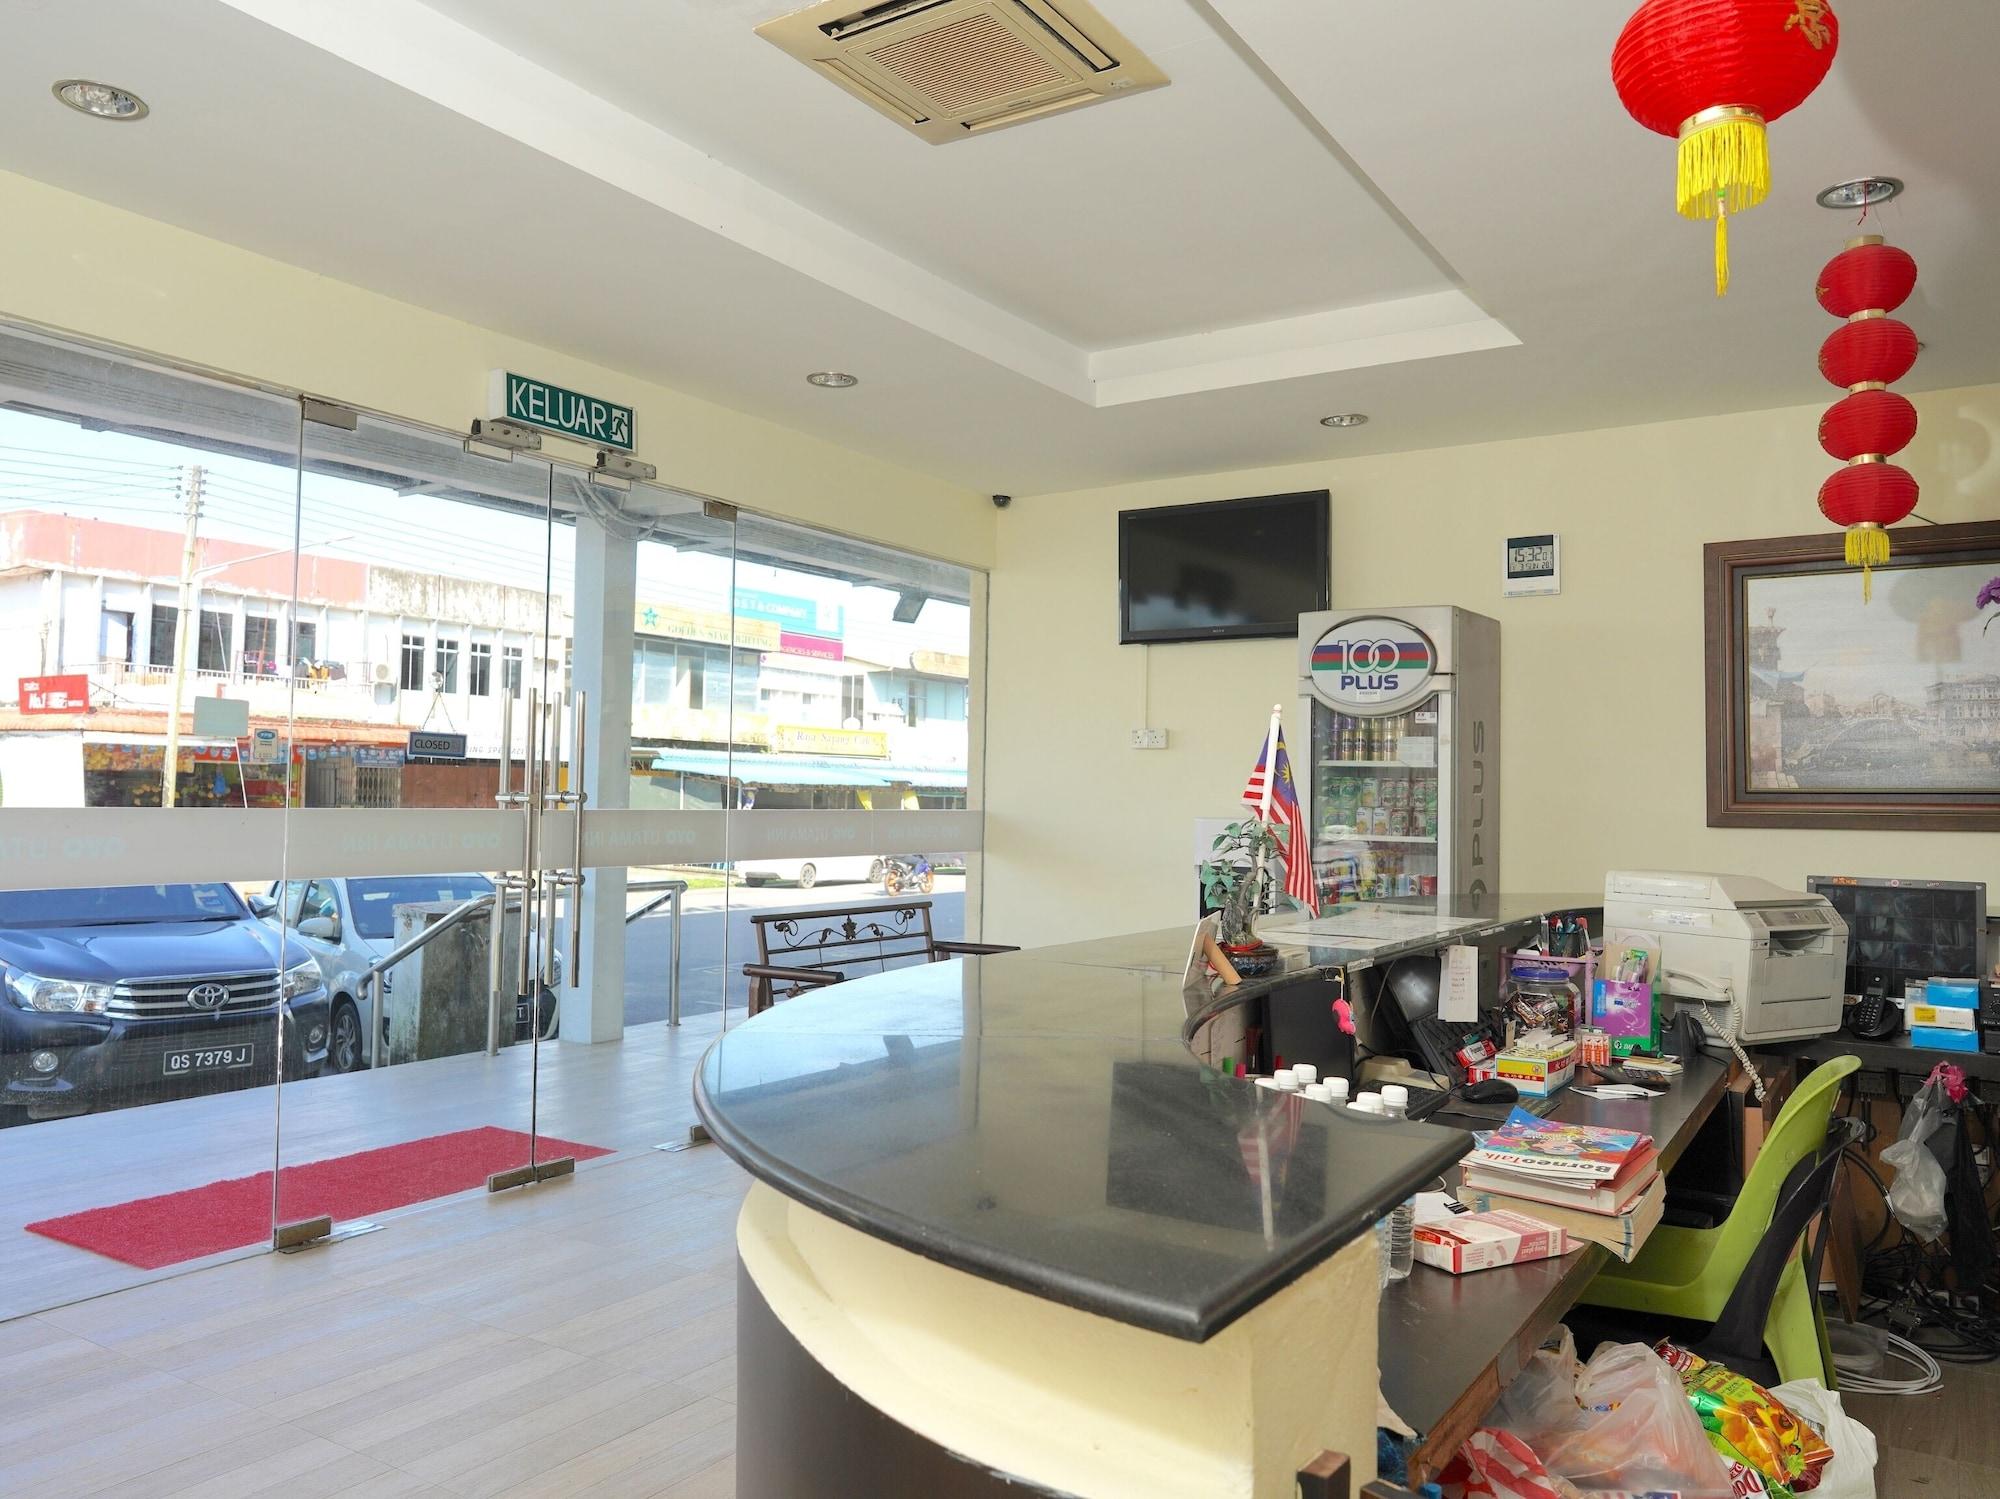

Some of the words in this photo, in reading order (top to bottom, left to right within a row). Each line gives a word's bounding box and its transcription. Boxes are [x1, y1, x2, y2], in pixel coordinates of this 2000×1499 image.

[511, 378, 607, 439] KELUAR
[1337, 639, 1400, 674] 100
[1341, 674, 1399, 691] PLUS
[414, 739, 451, 751] CLOSED
[1471, 720, 1485, 866] PLUS
[170, 1052, 190, 1069] QS
[195, 1050, 232, 1067] 7379
[236, 1048, 246, 1064] J
